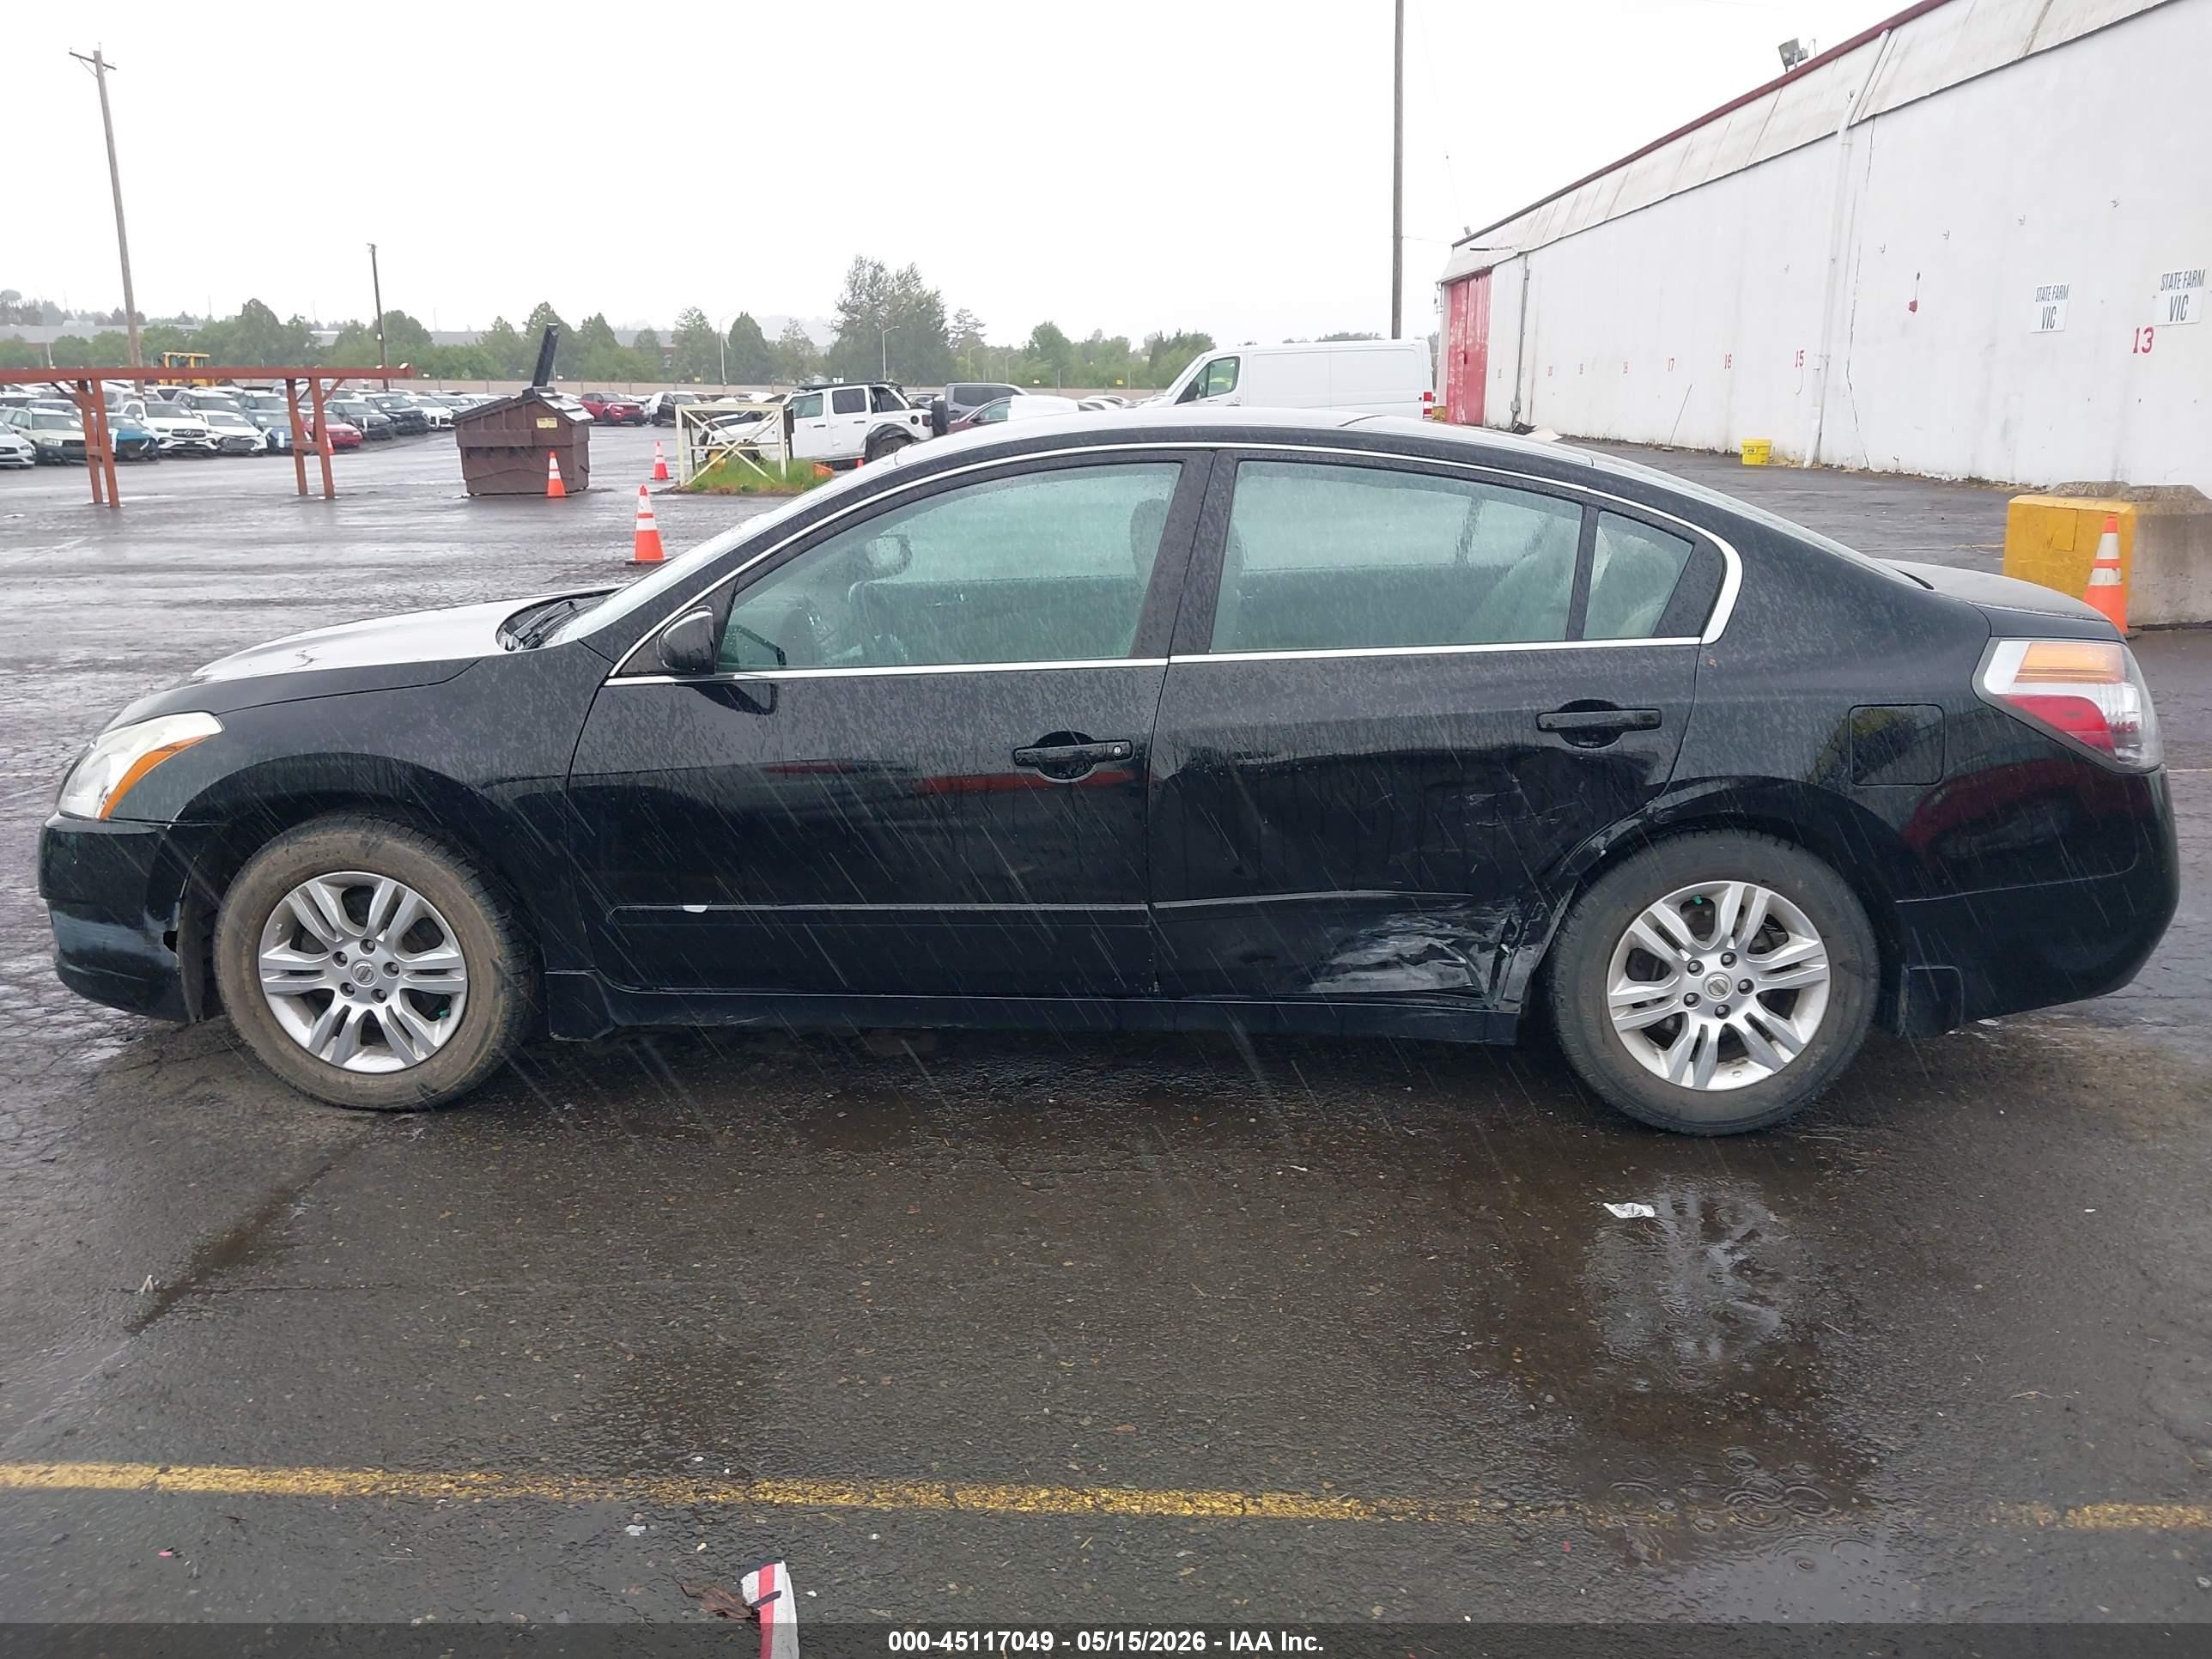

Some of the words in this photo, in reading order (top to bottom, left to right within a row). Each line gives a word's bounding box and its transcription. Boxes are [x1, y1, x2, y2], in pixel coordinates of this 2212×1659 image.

[2160, 272, 2182, 292] STATE
[2183, 269, 2206, 289] FARM
[2035, 286, 2051, 303] STATE
[2052, 284, 2069, 302] FARM
[2041, 306, 2057, 330] VIC
[2169, 295, 2190, 323] VIC
[2132, 325, 2155, 355] 13
[1668, 357, 1675, 372] 17
[1723, 354, 1732, 369] 16
[1795, 349, 1805, 368] 15
